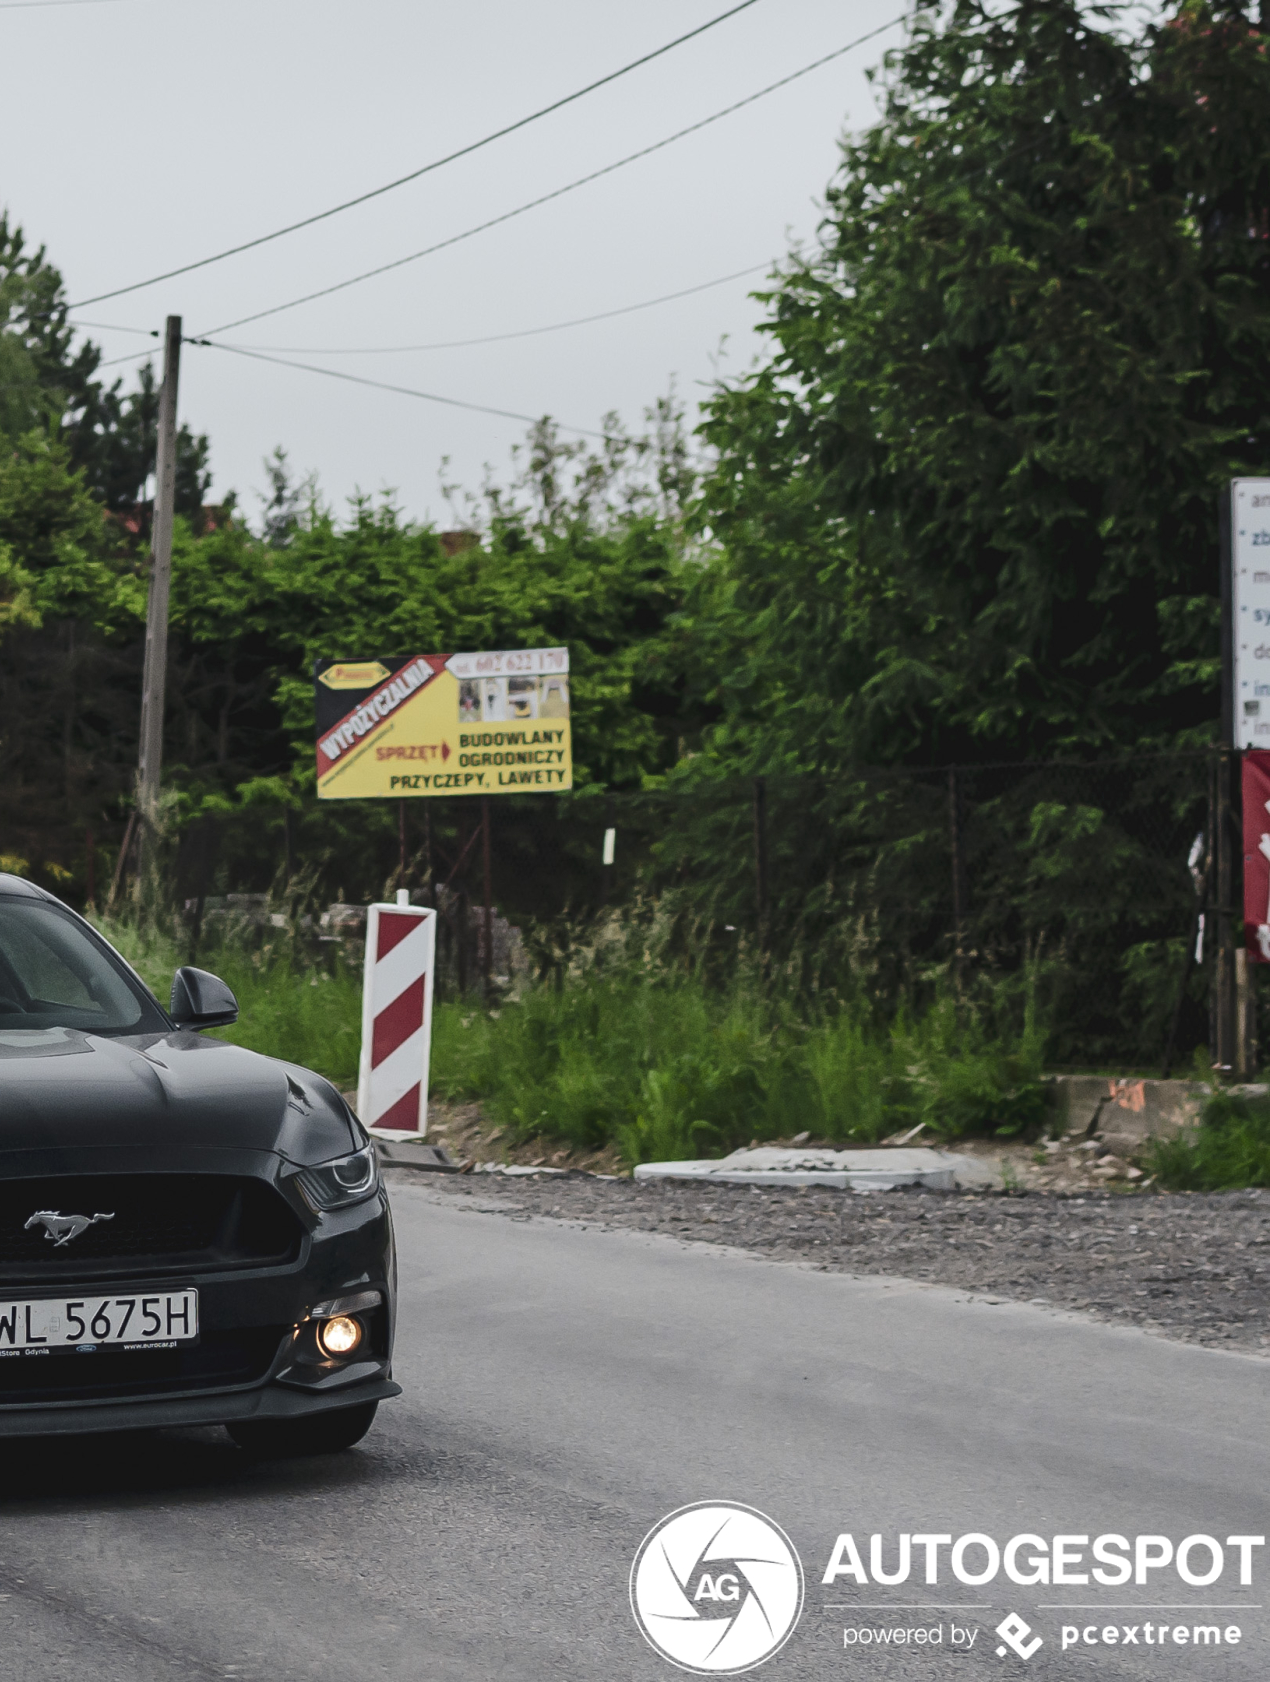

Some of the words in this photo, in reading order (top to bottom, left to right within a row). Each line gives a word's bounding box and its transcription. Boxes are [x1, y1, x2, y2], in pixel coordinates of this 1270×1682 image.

[320, 658, 434, 760] WYPOŻYCZALNIA
[460, 729, 565, 748] BUDOWLANY
[375, 745, 438, 764] SPRZĘT
[459, 750, 565, 768] OGRODNICZY
[390, 772, 490, 789] PRZYCZEPY,
[498, 769, 566, 786] LAWETY
[65, 1296, 189, 1341] 5675H
[25, 1348, 50, 1357] Gdynia
